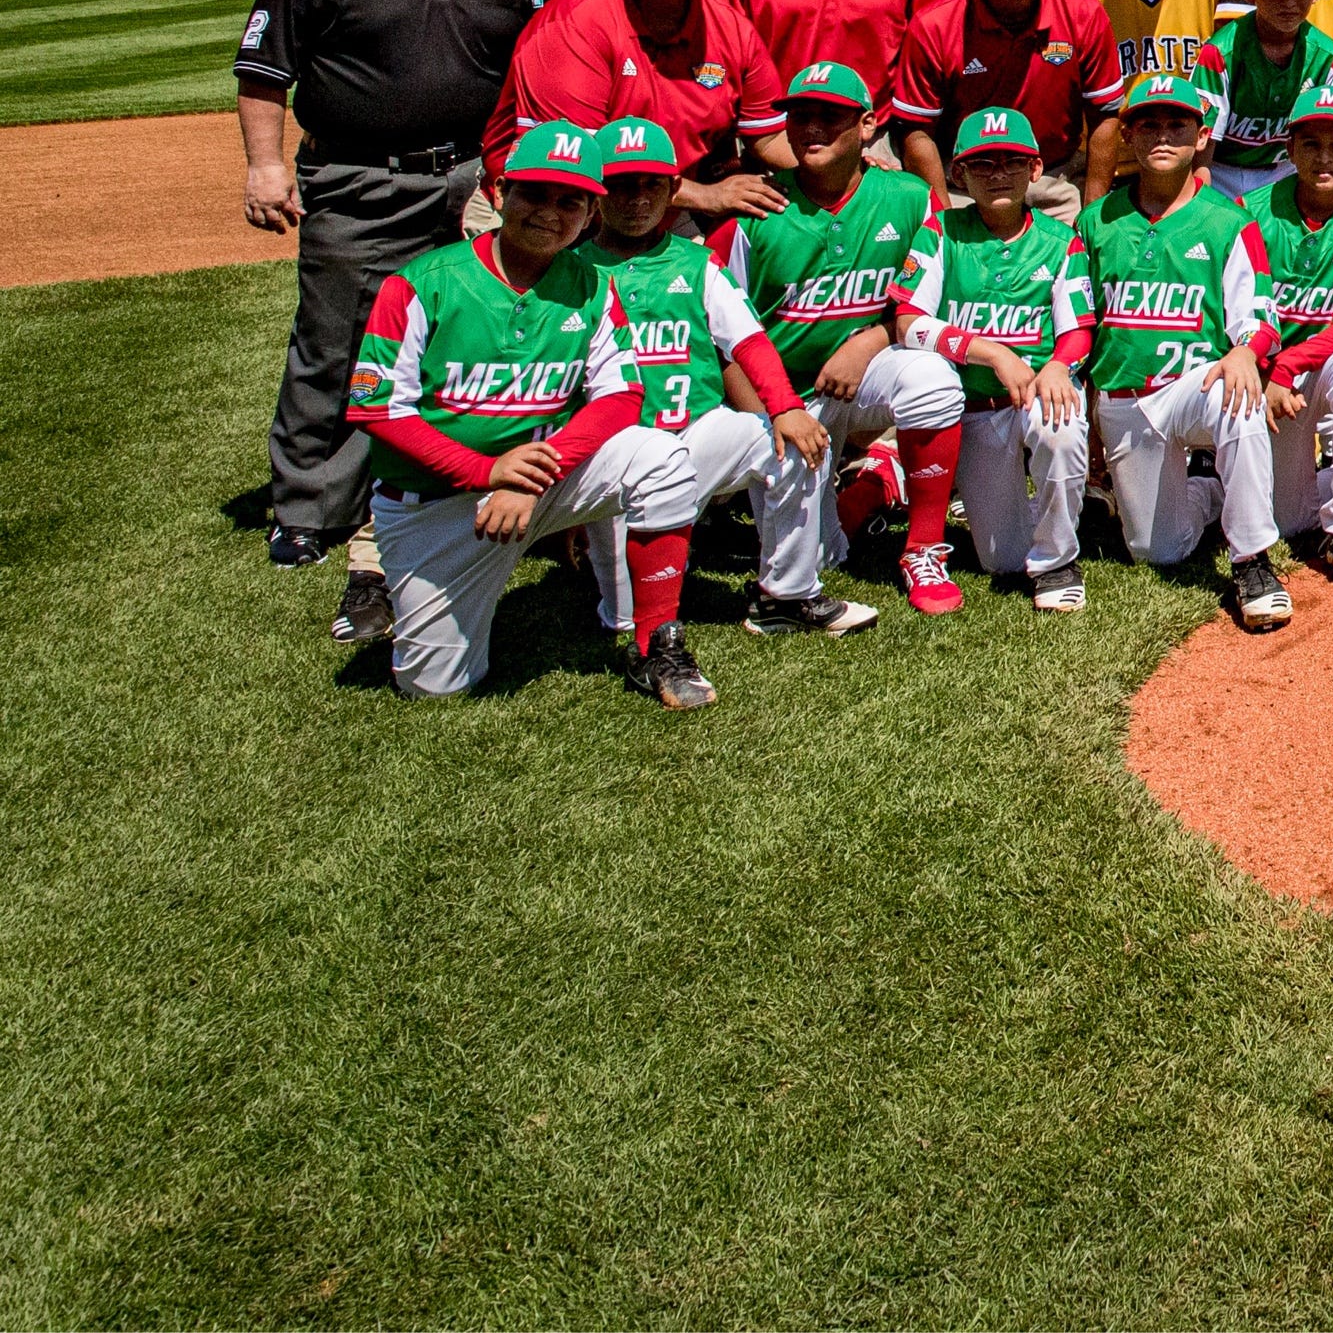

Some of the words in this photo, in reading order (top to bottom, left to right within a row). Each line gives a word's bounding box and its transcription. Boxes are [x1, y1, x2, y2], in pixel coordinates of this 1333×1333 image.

[241, 10, 270, 49] 2
[807, 64, 832, 83] M
[1149, 77, 1174, 94] M
[619, 126, 646, 149] M
[984, 114, 1008, 133] M
[553, 133, 582, 159] M
[783, 266, 900, 309] MEXICO
[1102, 281, 1206, 319] MEXICO
[948, 301, 1047, 334] MEXICO
[442, 359, 587, 401] MEXICO
[662, 374, 691, 424] 3
